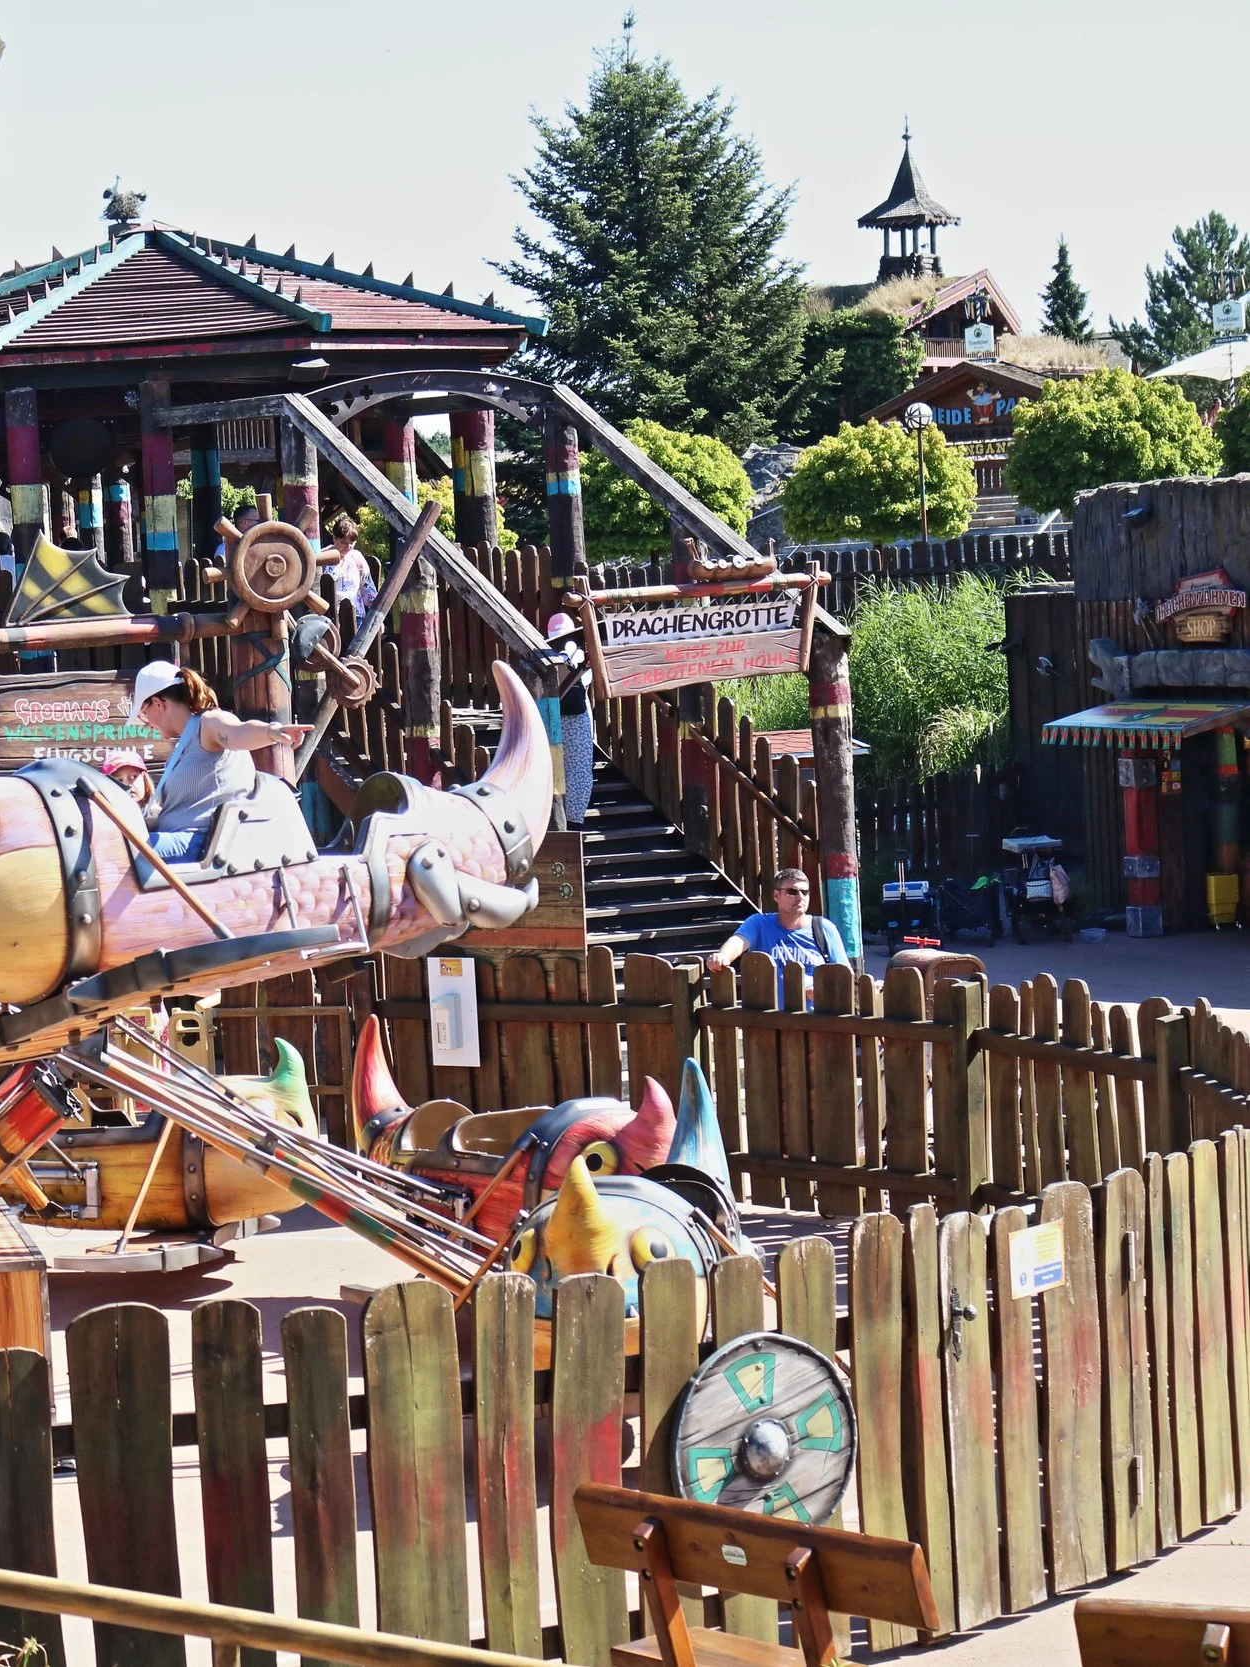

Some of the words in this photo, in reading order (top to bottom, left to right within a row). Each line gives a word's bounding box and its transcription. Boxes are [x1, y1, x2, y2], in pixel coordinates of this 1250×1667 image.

[612, 605, 789, 639] DRACHENGROTTE
[1187, 619, 1216, 638] SHOP
[664, 642, 711, 662] REISE
[716, 639, 746, 656] ZUR
[14, 698, 111, 726] GROBIANS
[3, 722, 163, 742] WOLKENSPRINGE
